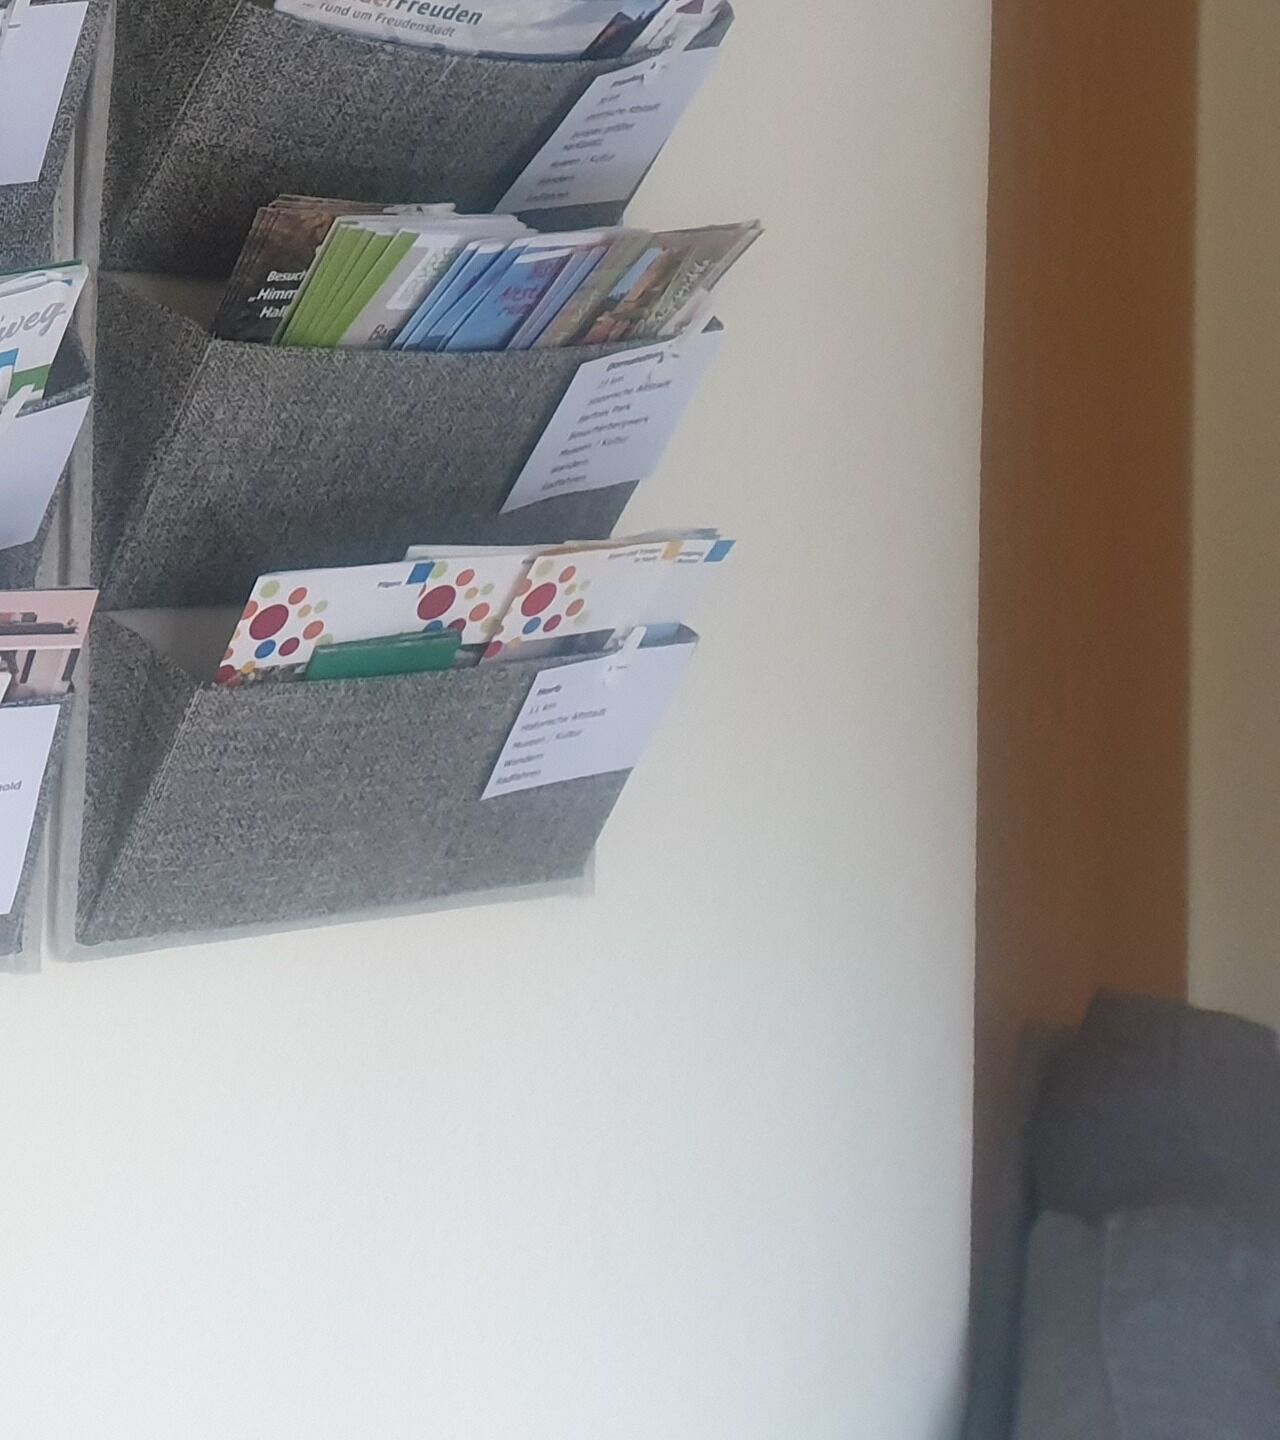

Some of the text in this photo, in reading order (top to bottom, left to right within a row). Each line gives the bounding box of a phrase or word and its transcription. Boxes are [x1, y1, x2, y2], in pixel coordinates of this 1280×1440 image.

[319, 2, 456, 39] rund um Freudenstadt
